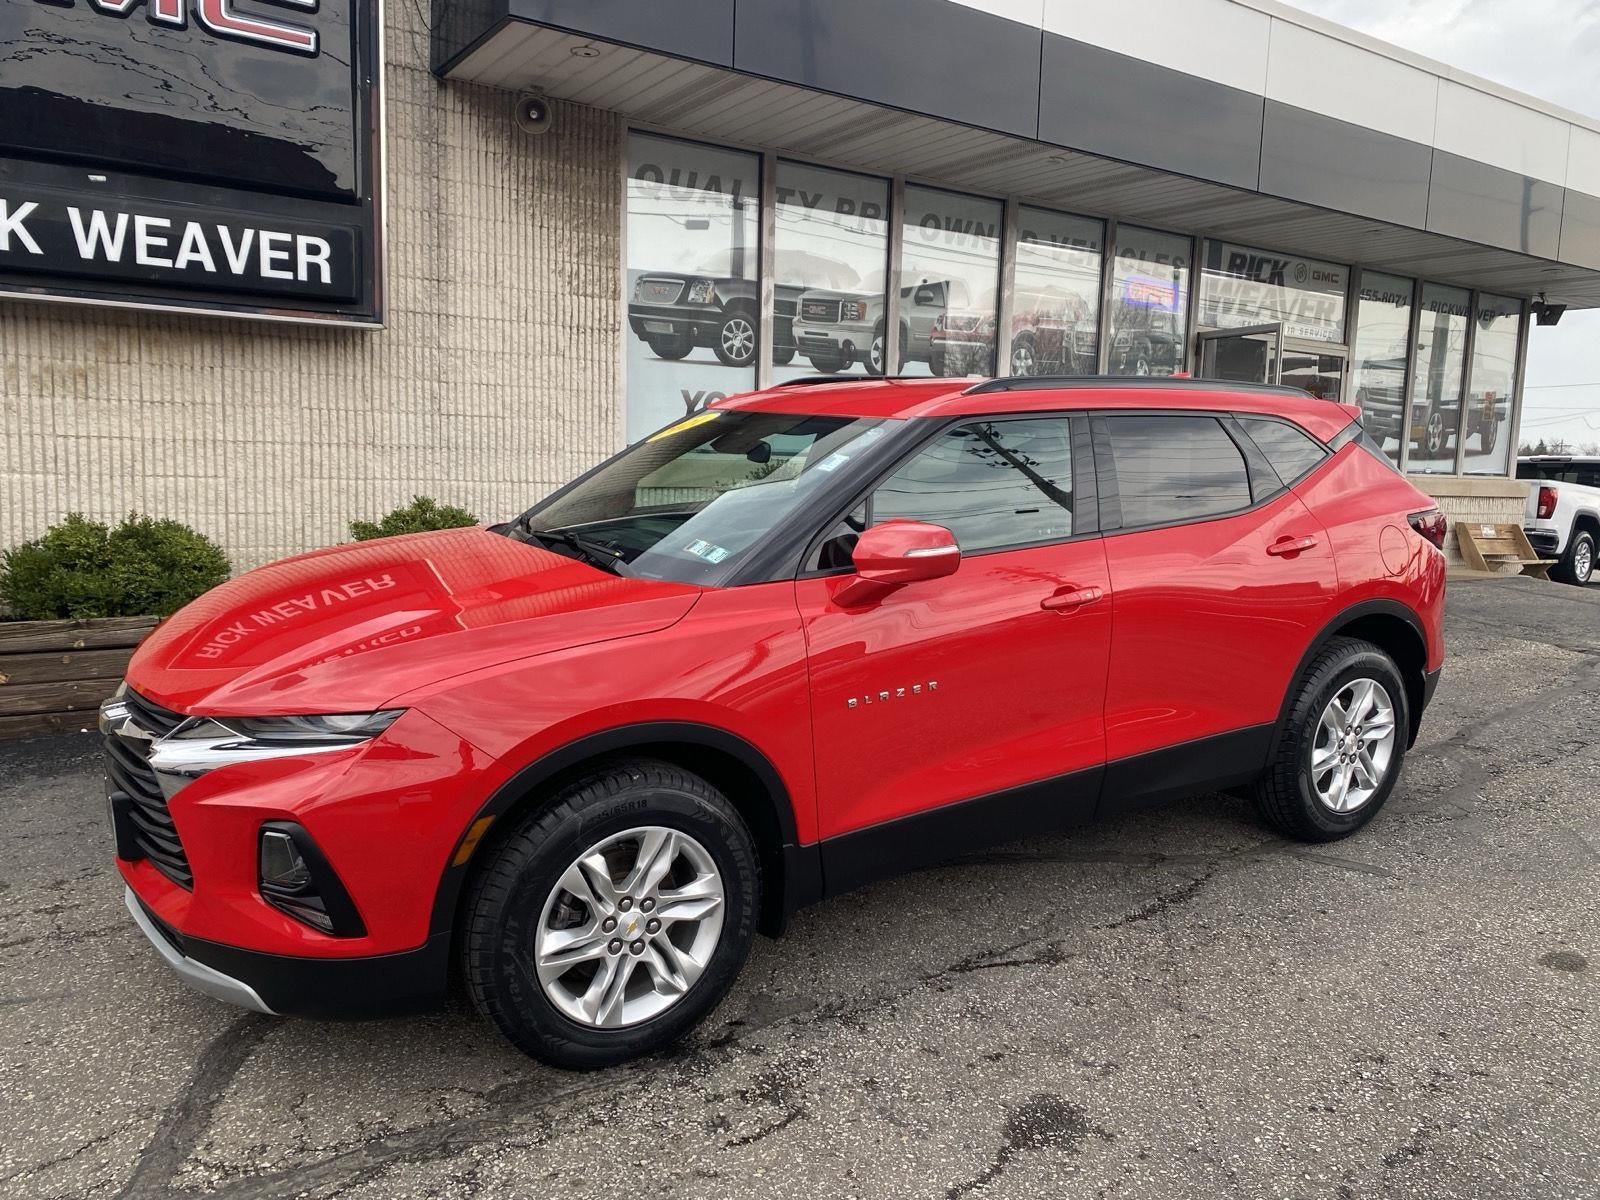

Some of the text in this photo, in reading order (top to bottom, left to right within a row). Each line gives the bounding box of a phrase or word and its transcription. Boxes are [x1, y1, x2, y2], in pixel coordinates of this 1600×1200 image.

[634, 164, 825, 222] QUALTY
[67, 206, 332, 284] WEAVER
[1227, 251, 1292, 287] RICK
[1312, 270, 1340, 284] GMC
[848, 681, 937, 708] BLAZER
